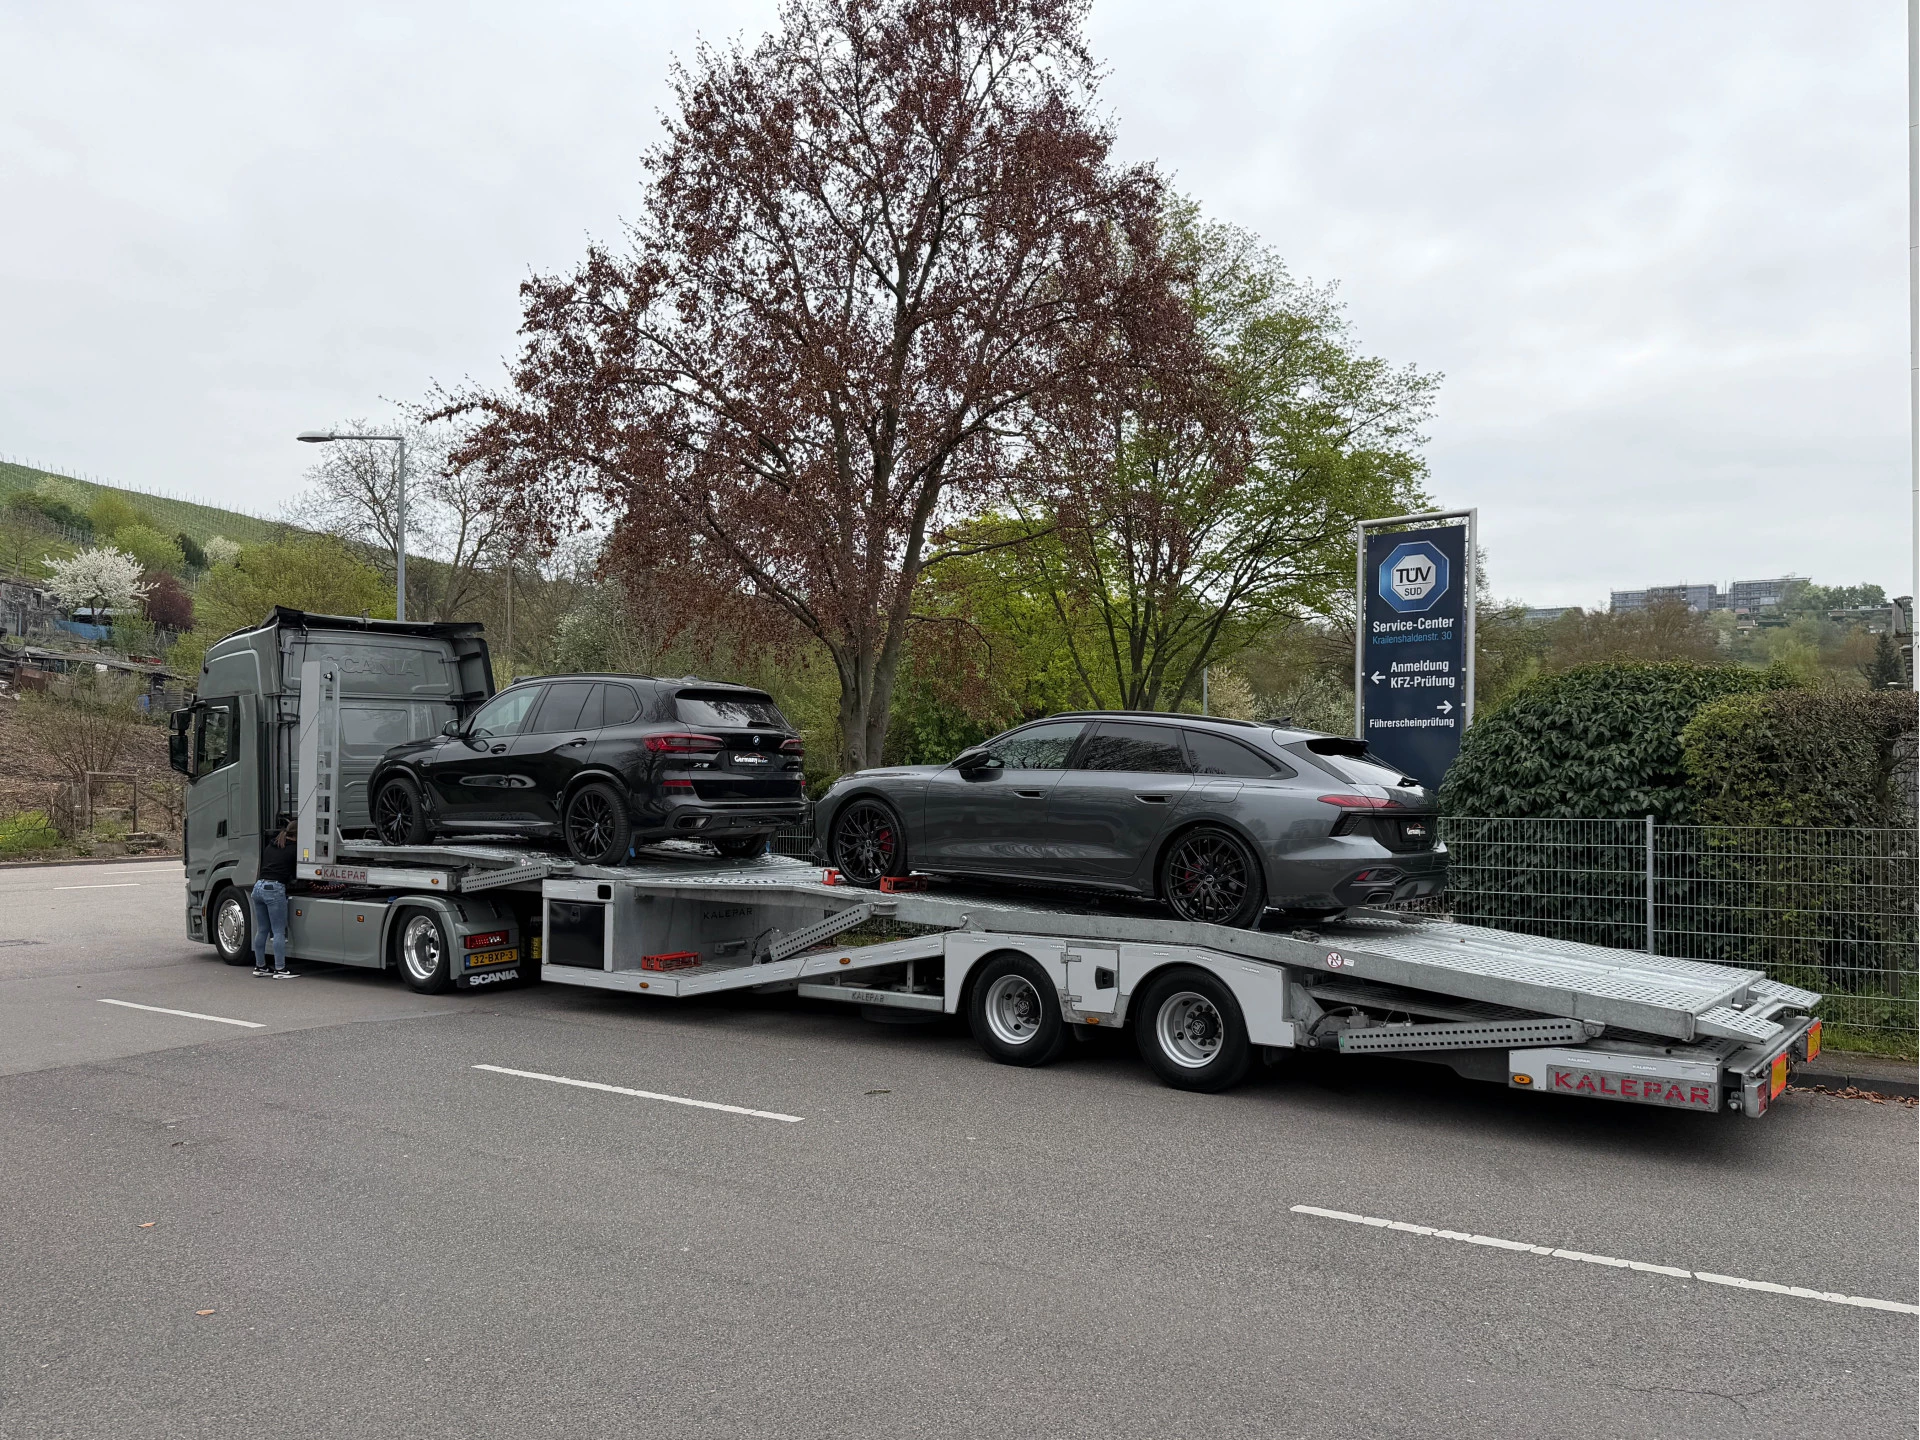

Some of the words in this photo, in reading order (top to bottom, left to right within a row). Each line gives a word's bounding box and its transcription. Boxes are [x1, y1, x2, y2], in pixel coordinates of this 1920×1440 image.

[1396, 566, 1431, 583] TÜV
[1404, 587, 1422, 596] SÜD
[1373, 617, 1454, 632] Service-Center
[1373, 633, 1439, 645] Krailenshaldenstr.
[1442, 631, 1452, 641] 30
[1391, 660, 1449, 674] Anmeldung
[1391, 675, 1455, 689] KFZ-Prüfung
[1370, 717, 1455, 729] Führerscheinprüfung
[324, 868, 366, 880] KALEPAR
[703, 907, 753, 920] KALEPAR
[473, 950, 513, 965] 32-BXP-3
[469, 969, 519, 986] SCANIA
[1555, 1071, 1709, 1105] KALEPAR
